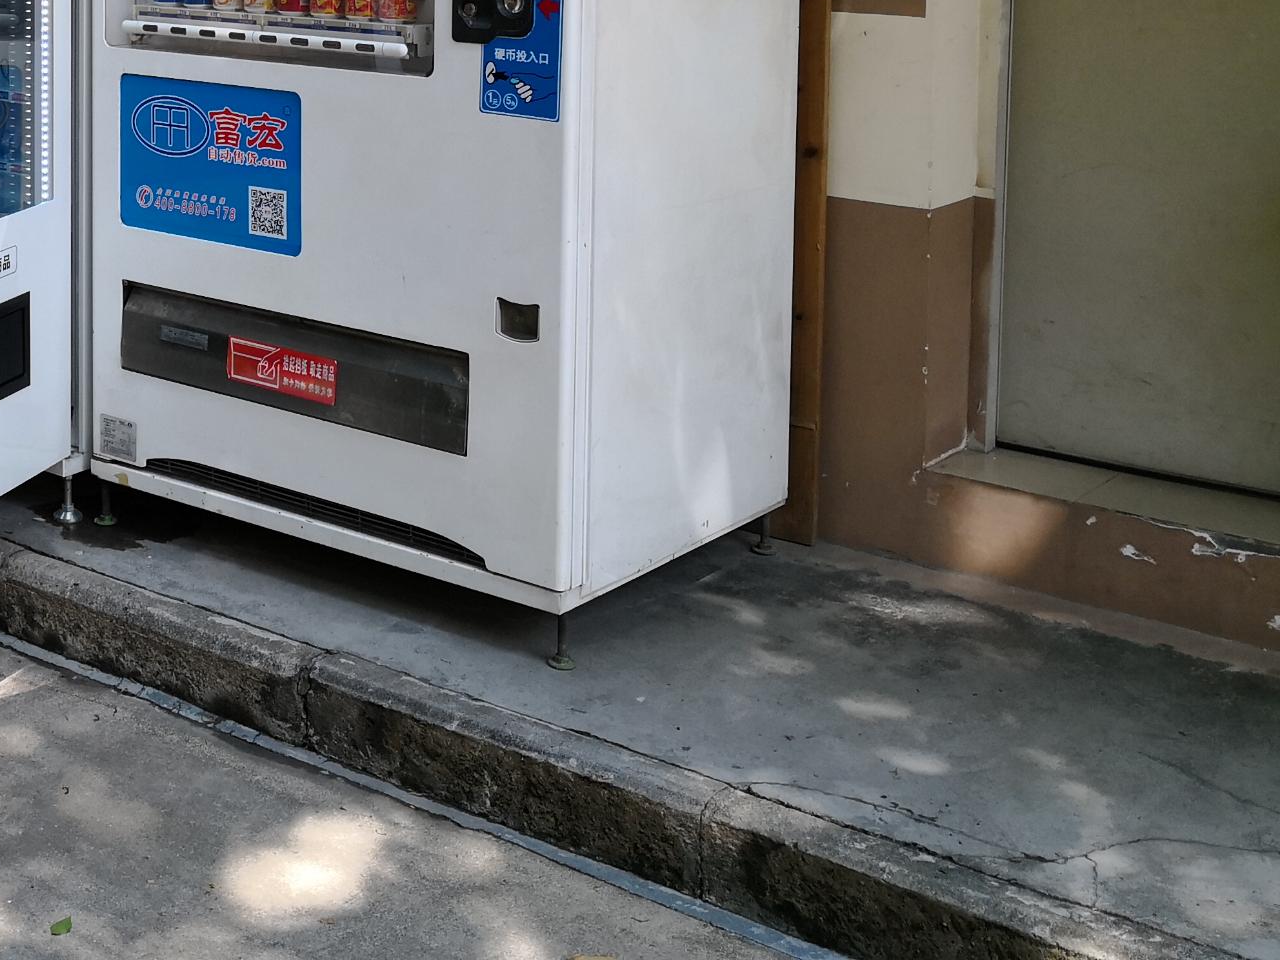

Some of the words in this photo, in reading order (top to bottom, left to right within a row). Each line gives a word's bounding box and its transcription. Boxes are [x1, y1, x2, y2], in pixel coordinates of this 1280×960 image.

[494, 48, 549, 65] 硬币投入口
[207, 106, 288, 152] 富宏
[208, 145, 288, 169] 自动售货.com
[153, 195, 236, 222] 400-8800-178
[309, 360, 335, 383] 取走商品
